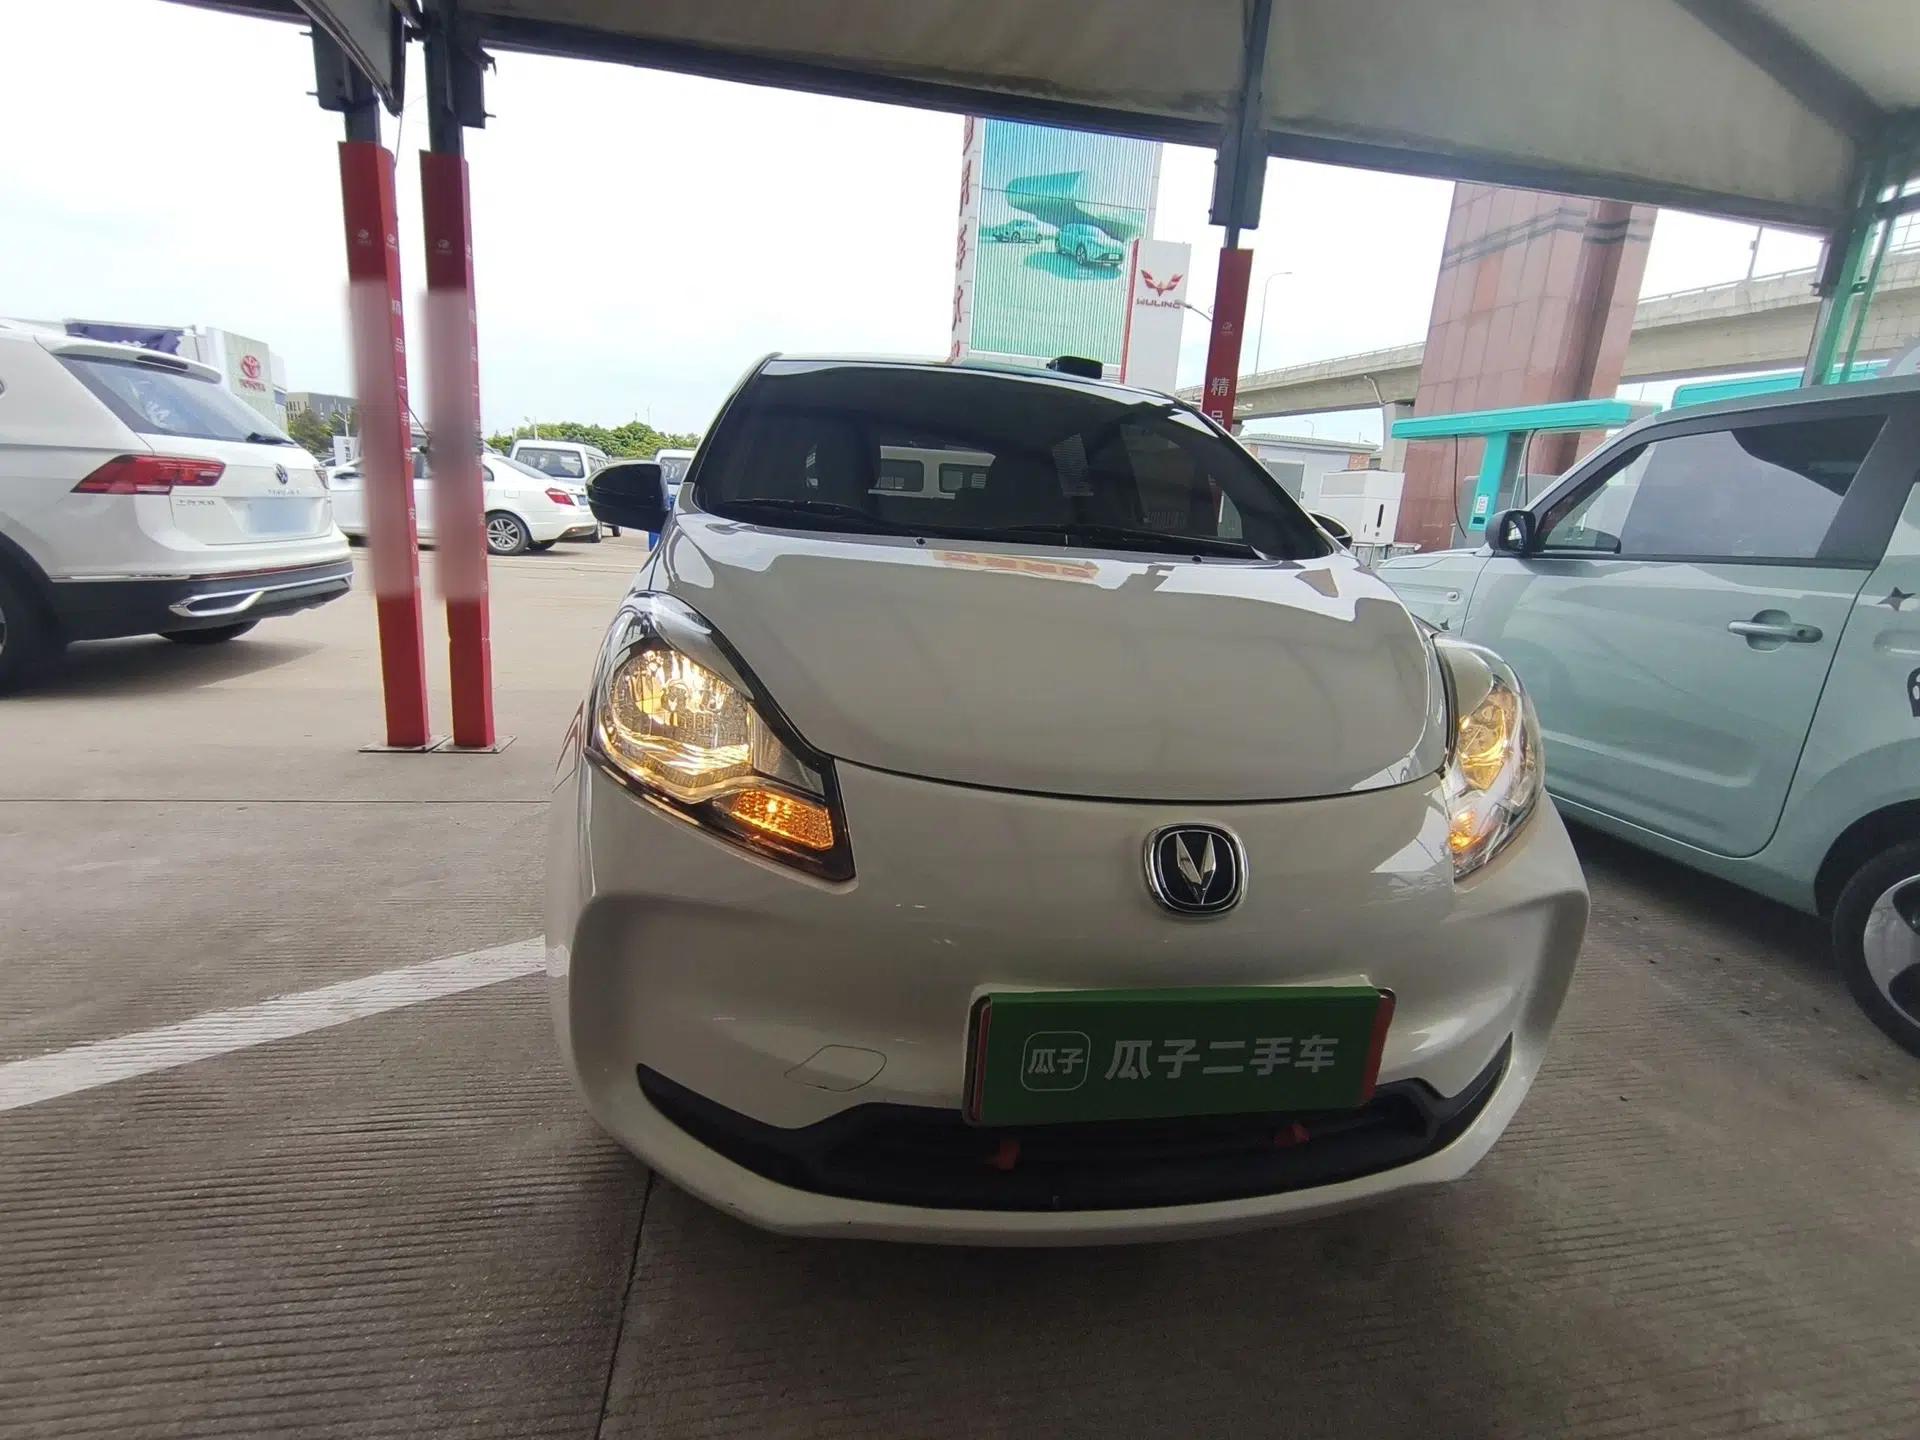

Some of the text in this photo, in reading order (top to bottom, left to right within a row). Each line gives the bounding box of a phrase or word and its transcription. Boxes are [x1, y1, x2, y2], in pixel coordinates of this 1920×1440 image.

[1027, 1047, 1084, 1075] 瓜子
[1105, 1034, 1339, 1080] 瓜子二手车
